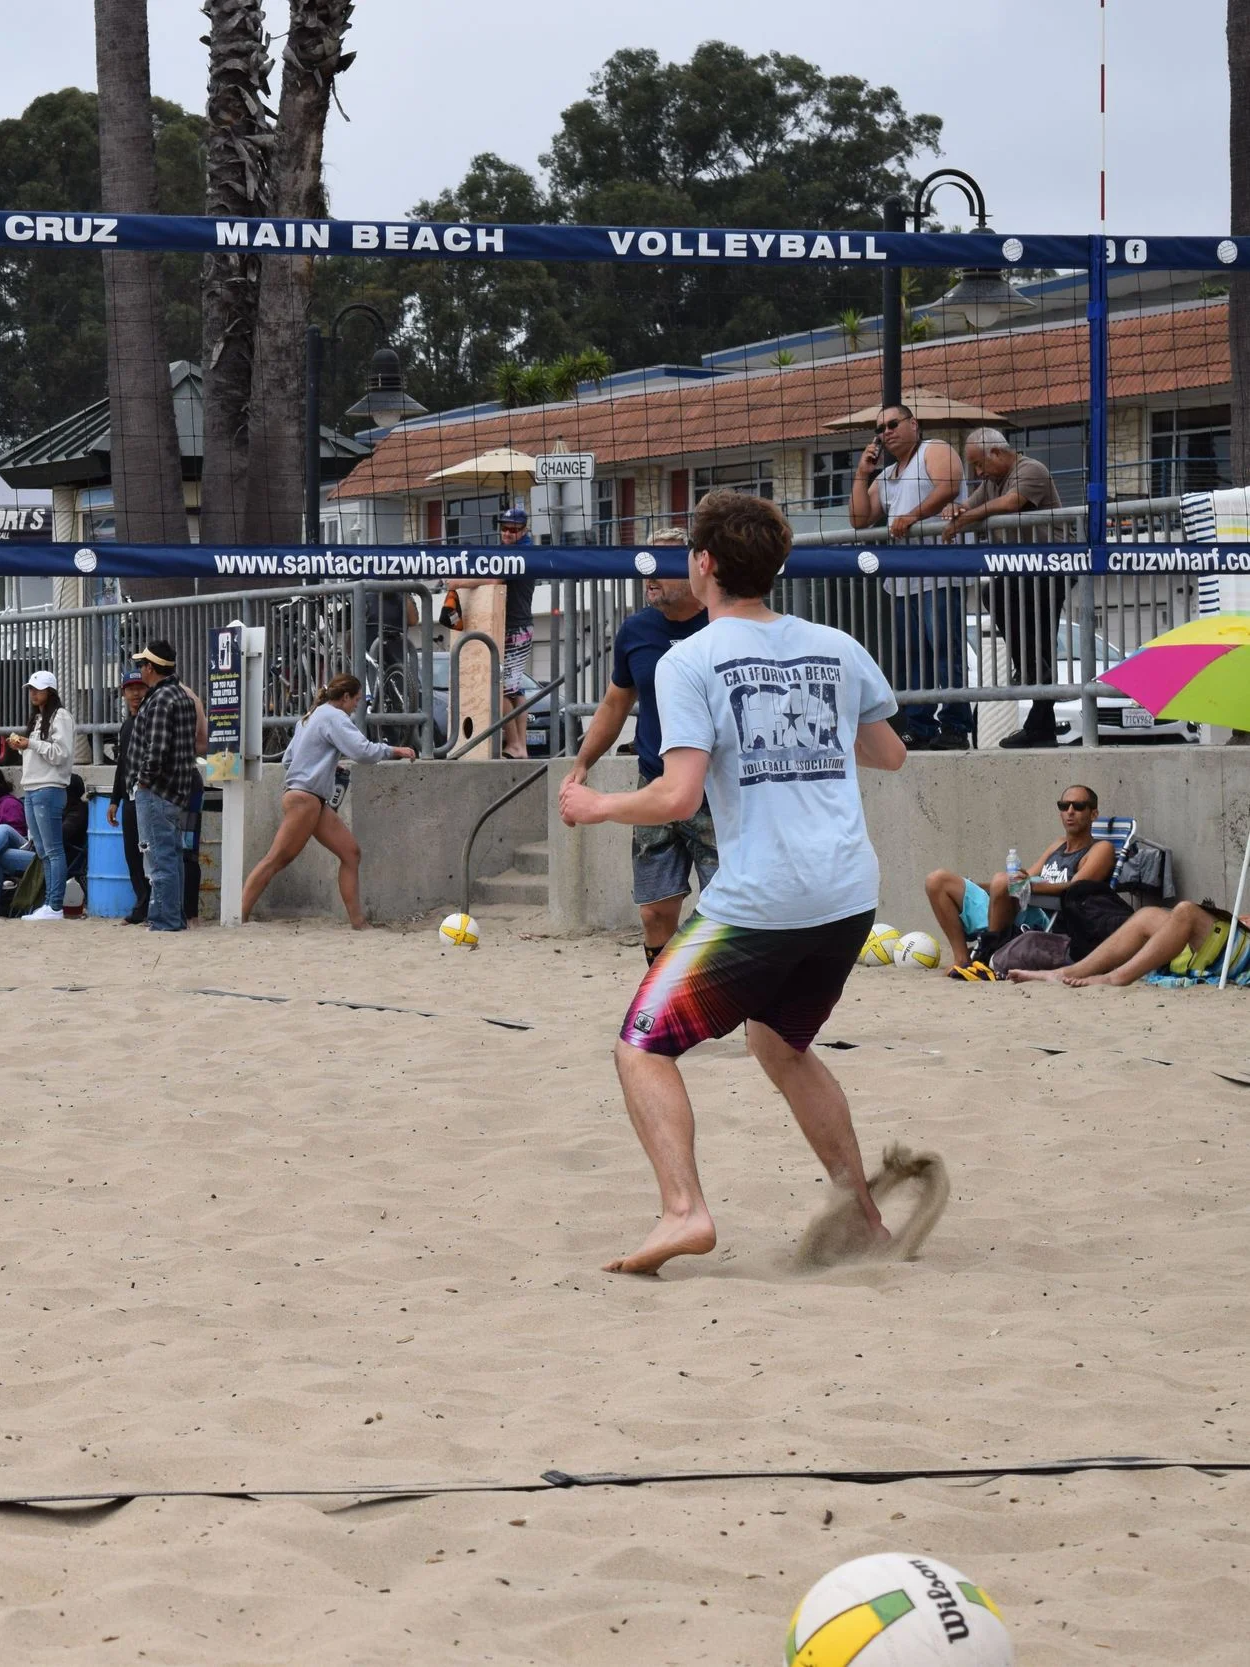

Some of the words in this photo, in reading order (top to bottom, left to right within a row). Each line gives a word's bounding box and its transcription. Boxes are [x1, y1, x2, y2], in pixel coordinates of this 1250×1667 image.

[5, 215, 118, 243] CRUZ
[215, 222, 330, 248] MAIN
[352, 225, 504, 252] BEACH
[608, 231, 888, 260] VOLLEYBALL
[540, 461, 587, 475] CHANGE
[214, 550, 526, 576] www.santacruzwharf.com
[723, 666, 802, 687] CALIFORNIA
[805, 666, 841, 682] BEACH
[908, 1559, 970, 1645] Wilson
